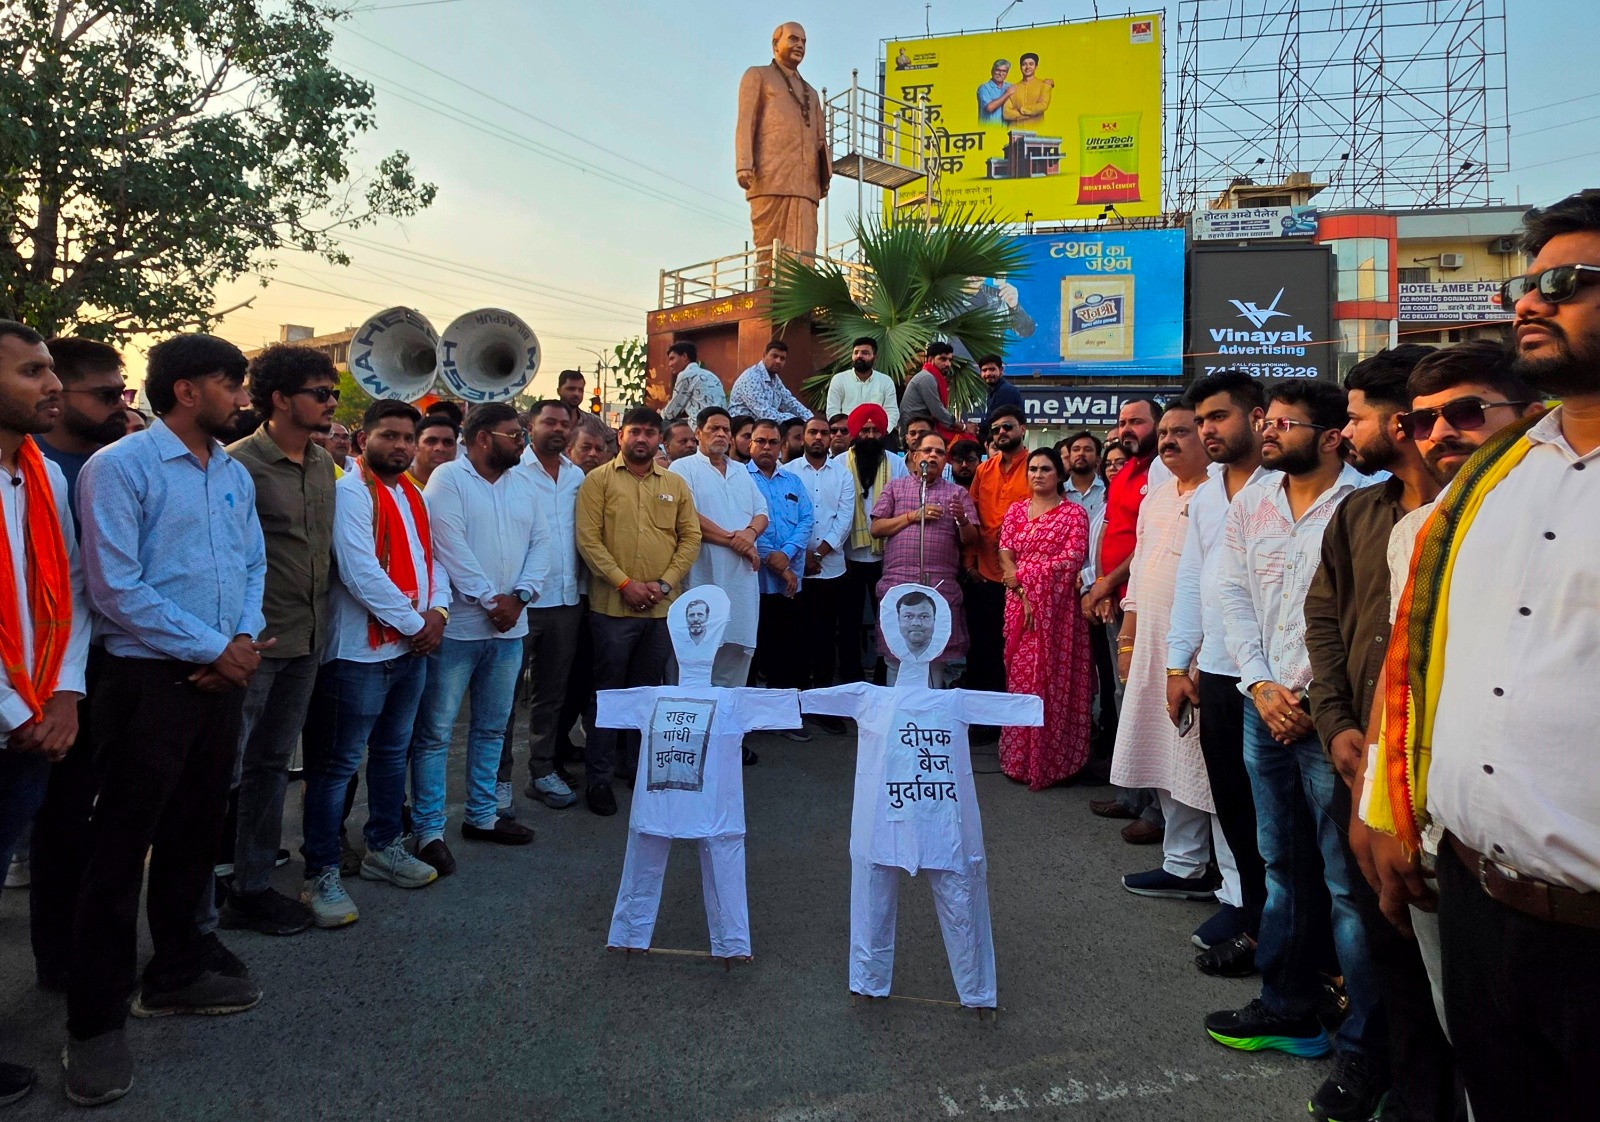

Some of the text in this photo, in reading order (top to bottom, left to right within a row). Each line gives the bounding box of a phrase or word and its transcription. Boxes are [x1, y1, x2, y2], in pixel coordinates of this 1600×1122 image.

[901, 84, 934, 103] घर
[1086, 135, 1134, 146] UltraTech
[965, 185, 980, 194] करने
[1203, 209, 1279, 221] होटल अम्बे पैलेस
[1049, 241, 1124, 259] टशन का
[1085, 256, 1133, 272] जश्न
[1400, 284, 1438, 293] HOTEL
[1441, 283, 1474, 293] AMBE
[1077, 301, 1116, 321] राजश्री
[474, 313, 530, 341] BILASPUR
[1209, 325, 1313, 345] Vinayak
[1218, 344, 1306, 357] Advertising
[443, 340, 536, 401] MAHESH
[666, 711, 698, 725] राहुल
[663, 727, 692, 743] गांधी
[899, 722, 952, 747] दीपक
[656, 745, 697, 768] मुर्दाबाद
[886, 774, 958, 809] मुर्दाबाद
